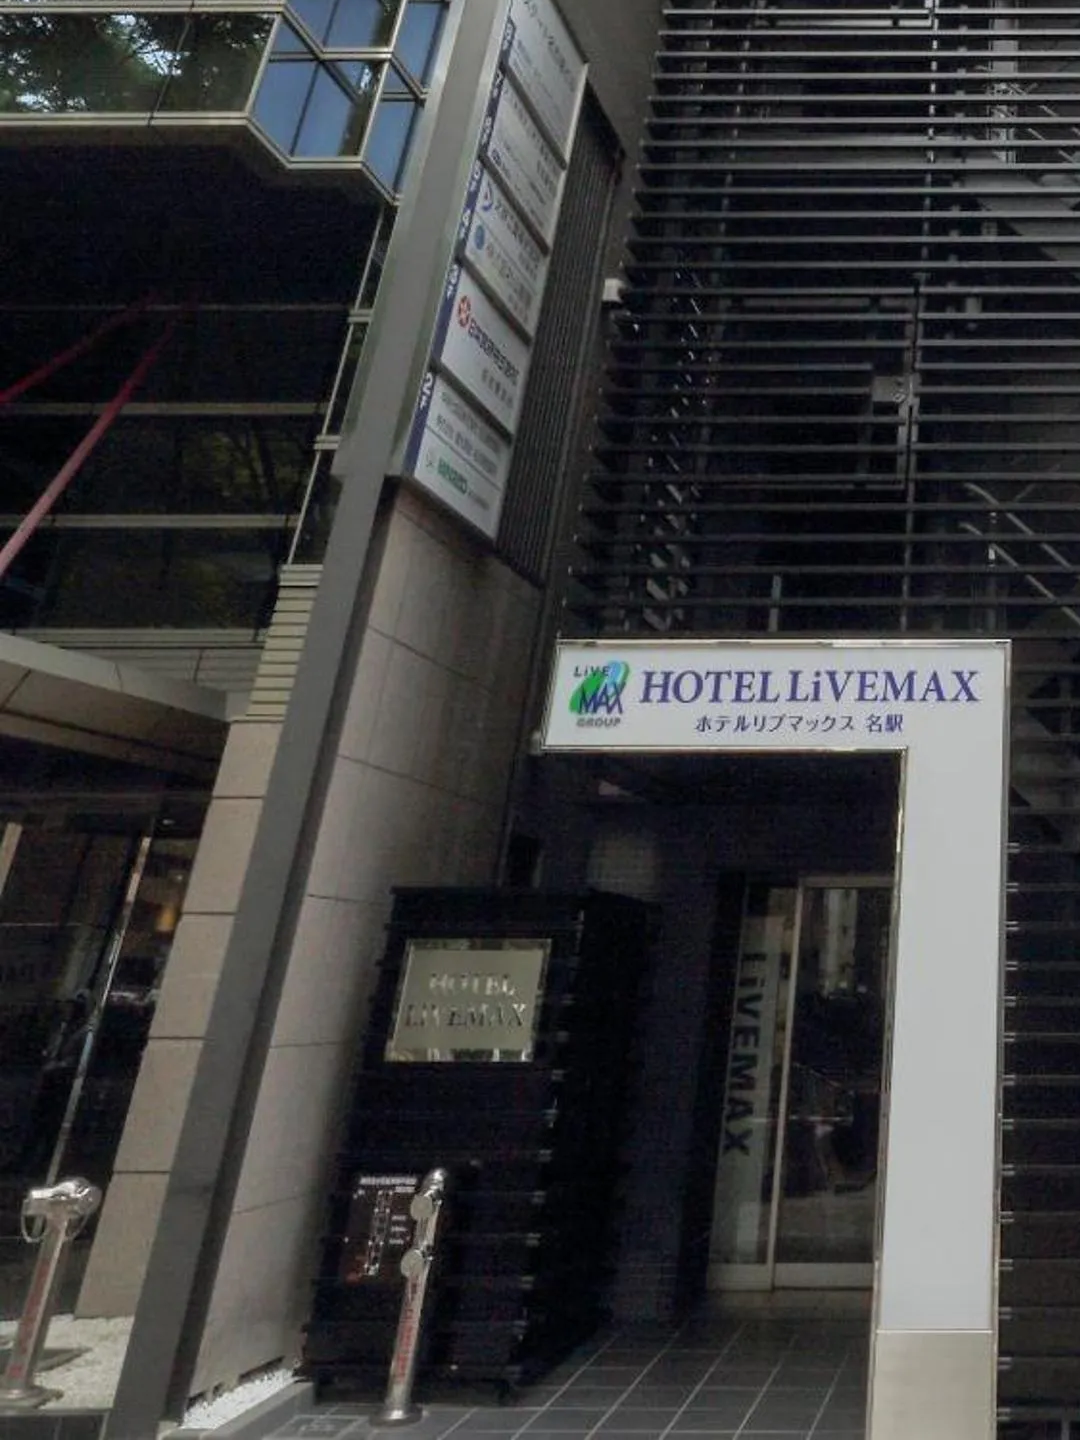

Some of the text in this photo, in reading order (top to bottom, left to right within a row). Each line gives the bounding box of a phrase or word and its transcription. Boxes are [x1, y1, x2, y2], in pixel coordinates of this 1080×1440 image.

[573, 665, 611, 678] LiVE
[578, 681, 626, 715] MAX
[639, 669, 981, 704] HOTEL LiVEMAX
[576, 717, 622, 728] GROUP
[695, 713, 904, 733] ホテルリブマックス 名駅
[429, 973, 516, 996] HOTEL
[722, 952, 768, 1157] LiVEMAX
